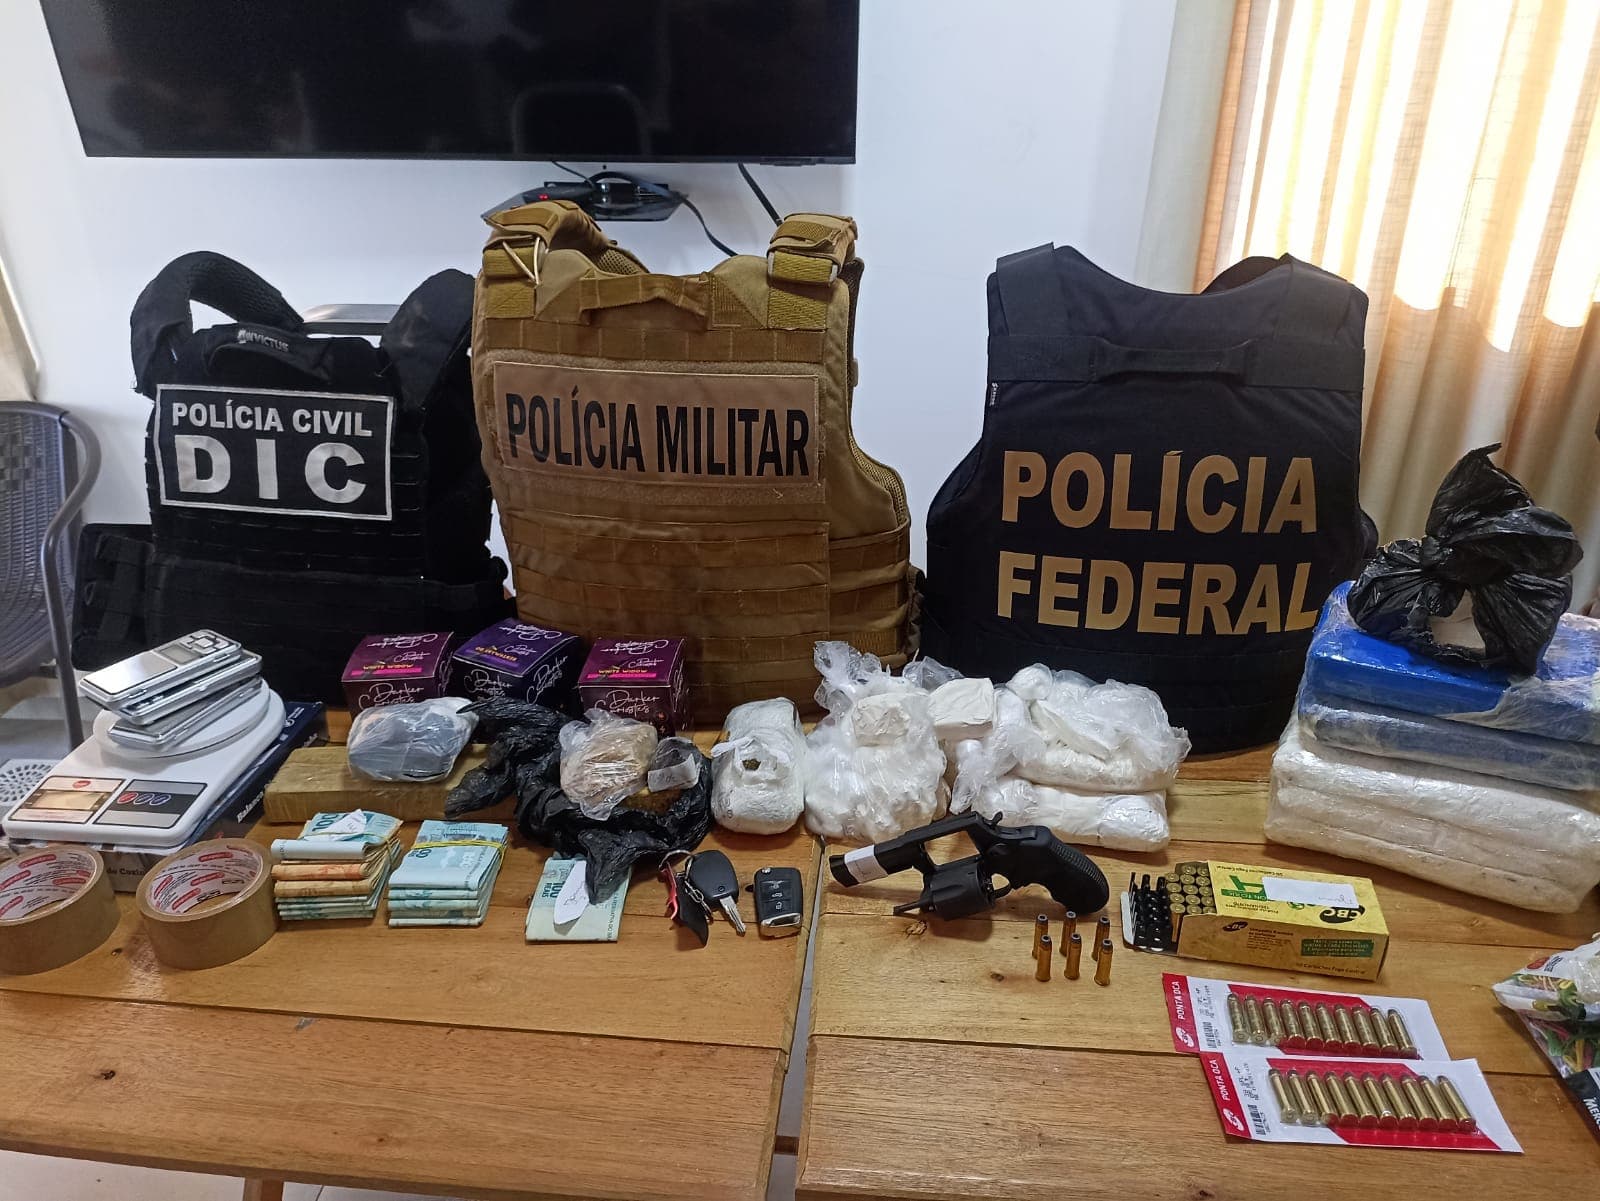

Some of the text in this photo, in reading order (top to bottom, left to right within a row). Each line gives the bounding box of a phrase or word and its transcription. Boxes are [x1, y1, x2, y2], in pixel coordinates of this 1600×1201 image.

[172, 399, 373, 437] POLÍCIA CIVIL
[505, 385, 810, 477] POLÍCIA MILITAR
[1001, 450, 1318, 534] POLÍCIA
[997, 550, 1319, 635] FEDERAL
[1324, 908, 1361, 919] CBC
[1174, 996, 1185, 1021] PONTA
[1215, 1075, 1230, 1101] PONTA
